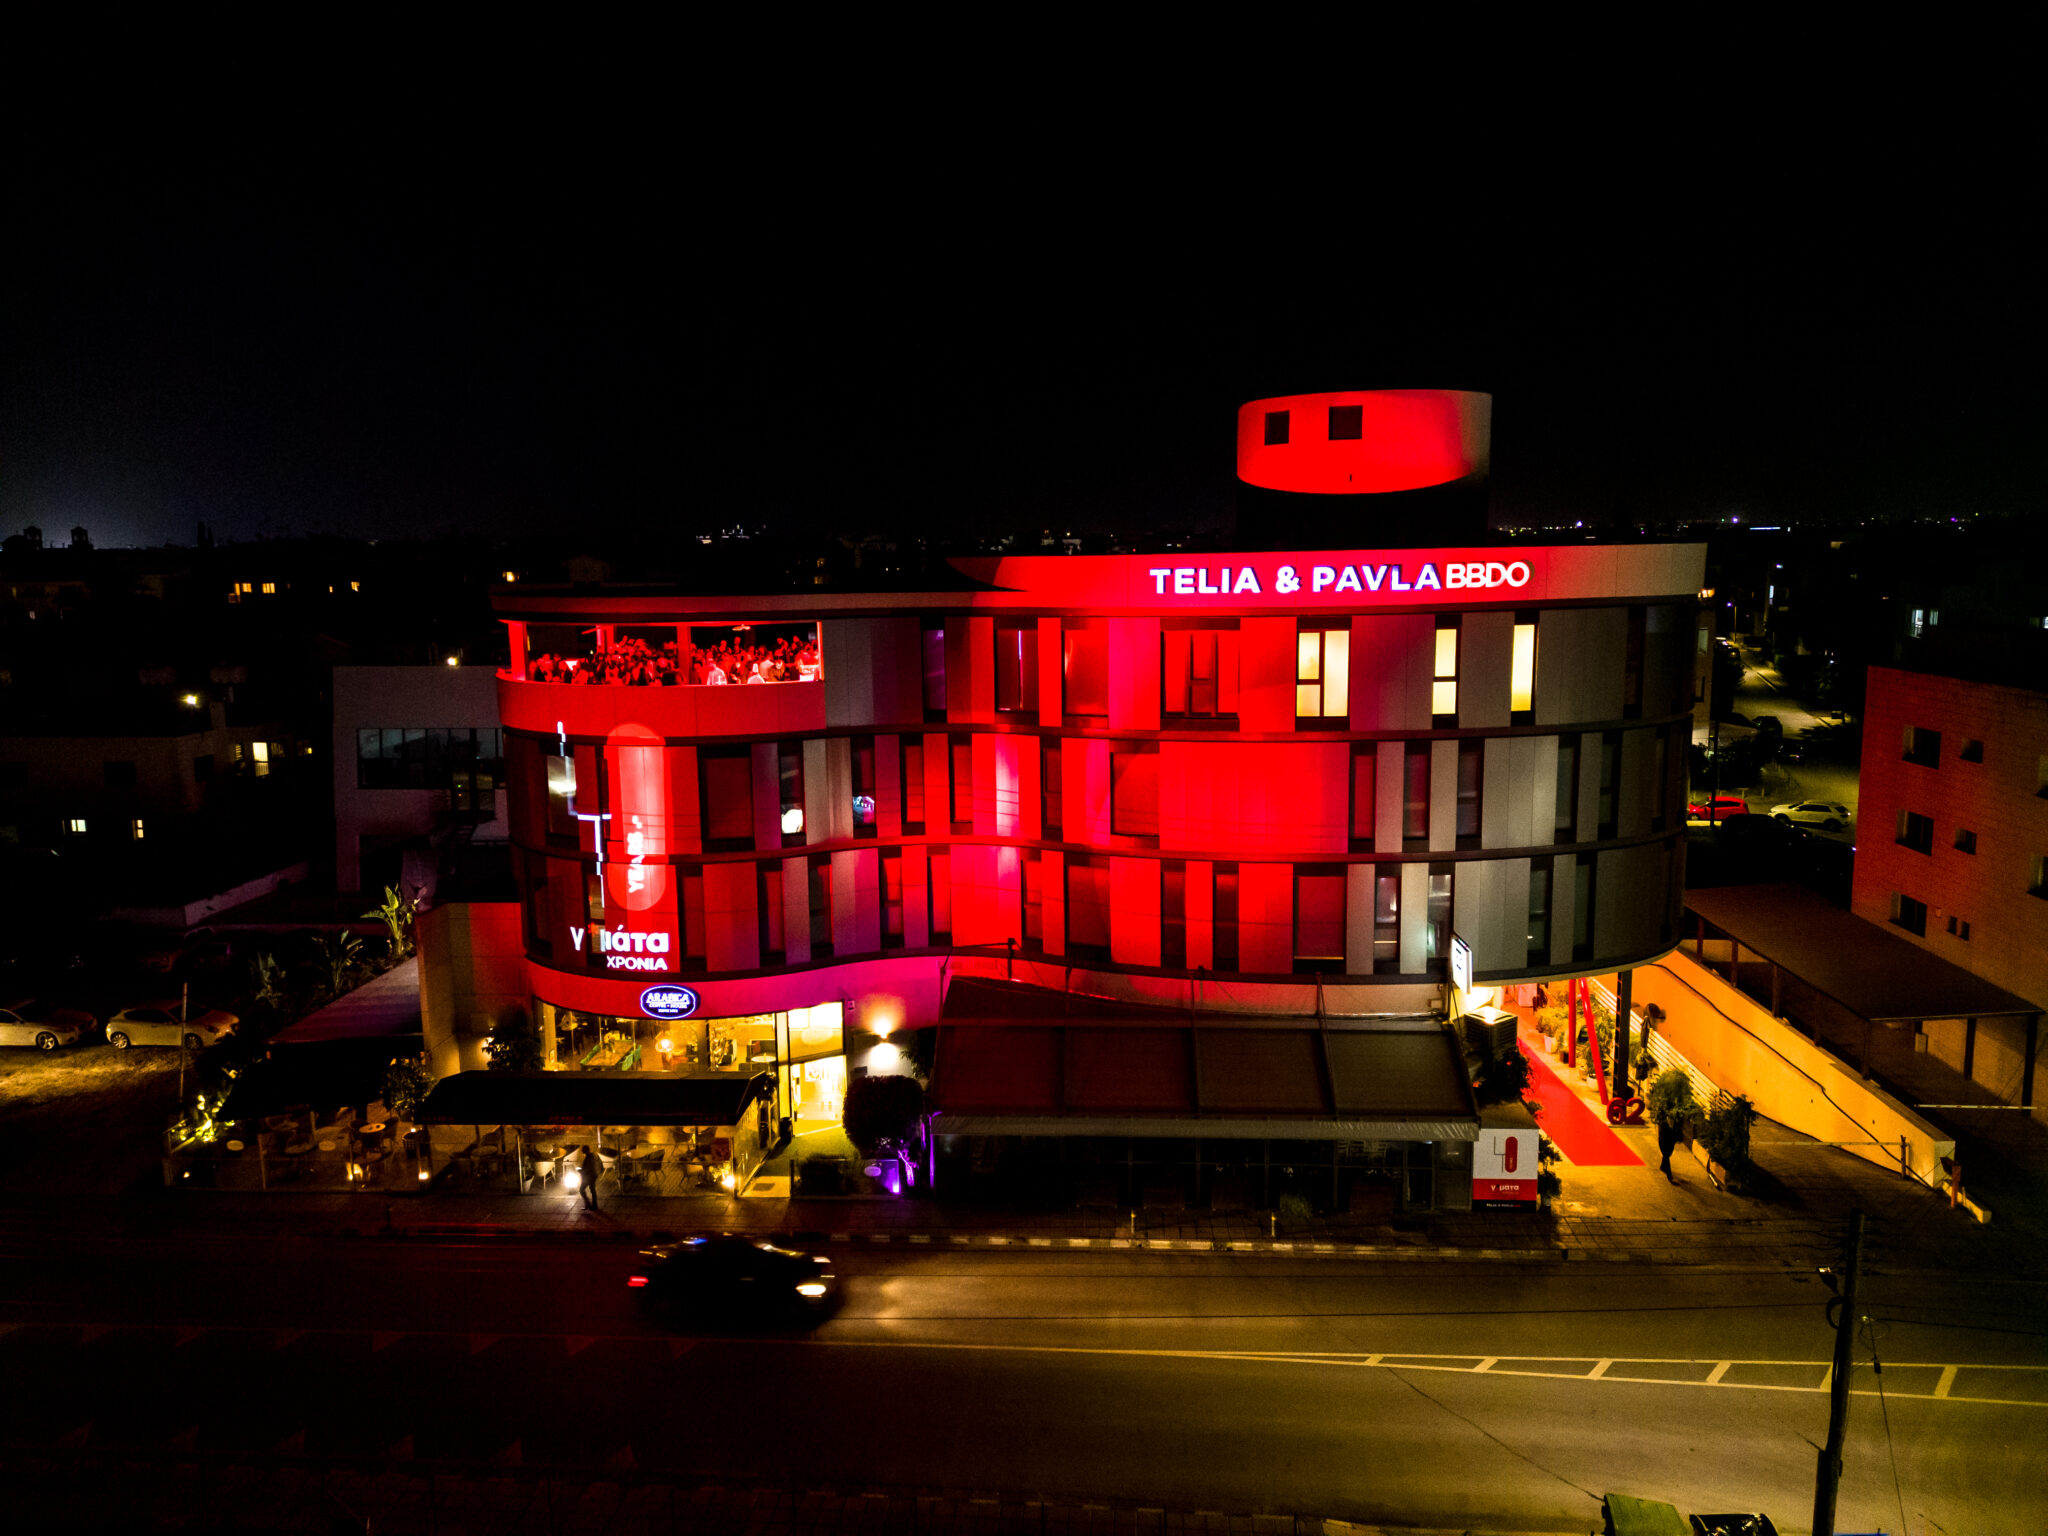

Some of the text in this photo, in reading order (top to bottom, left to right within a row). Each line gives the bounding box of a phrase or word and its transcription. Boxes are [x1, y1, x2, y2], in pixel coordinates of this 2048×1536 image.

[1150, 561, 1532, 594] TELIA & PAVLA BBDO
[1606, 1096, 1646, 1125] 62
